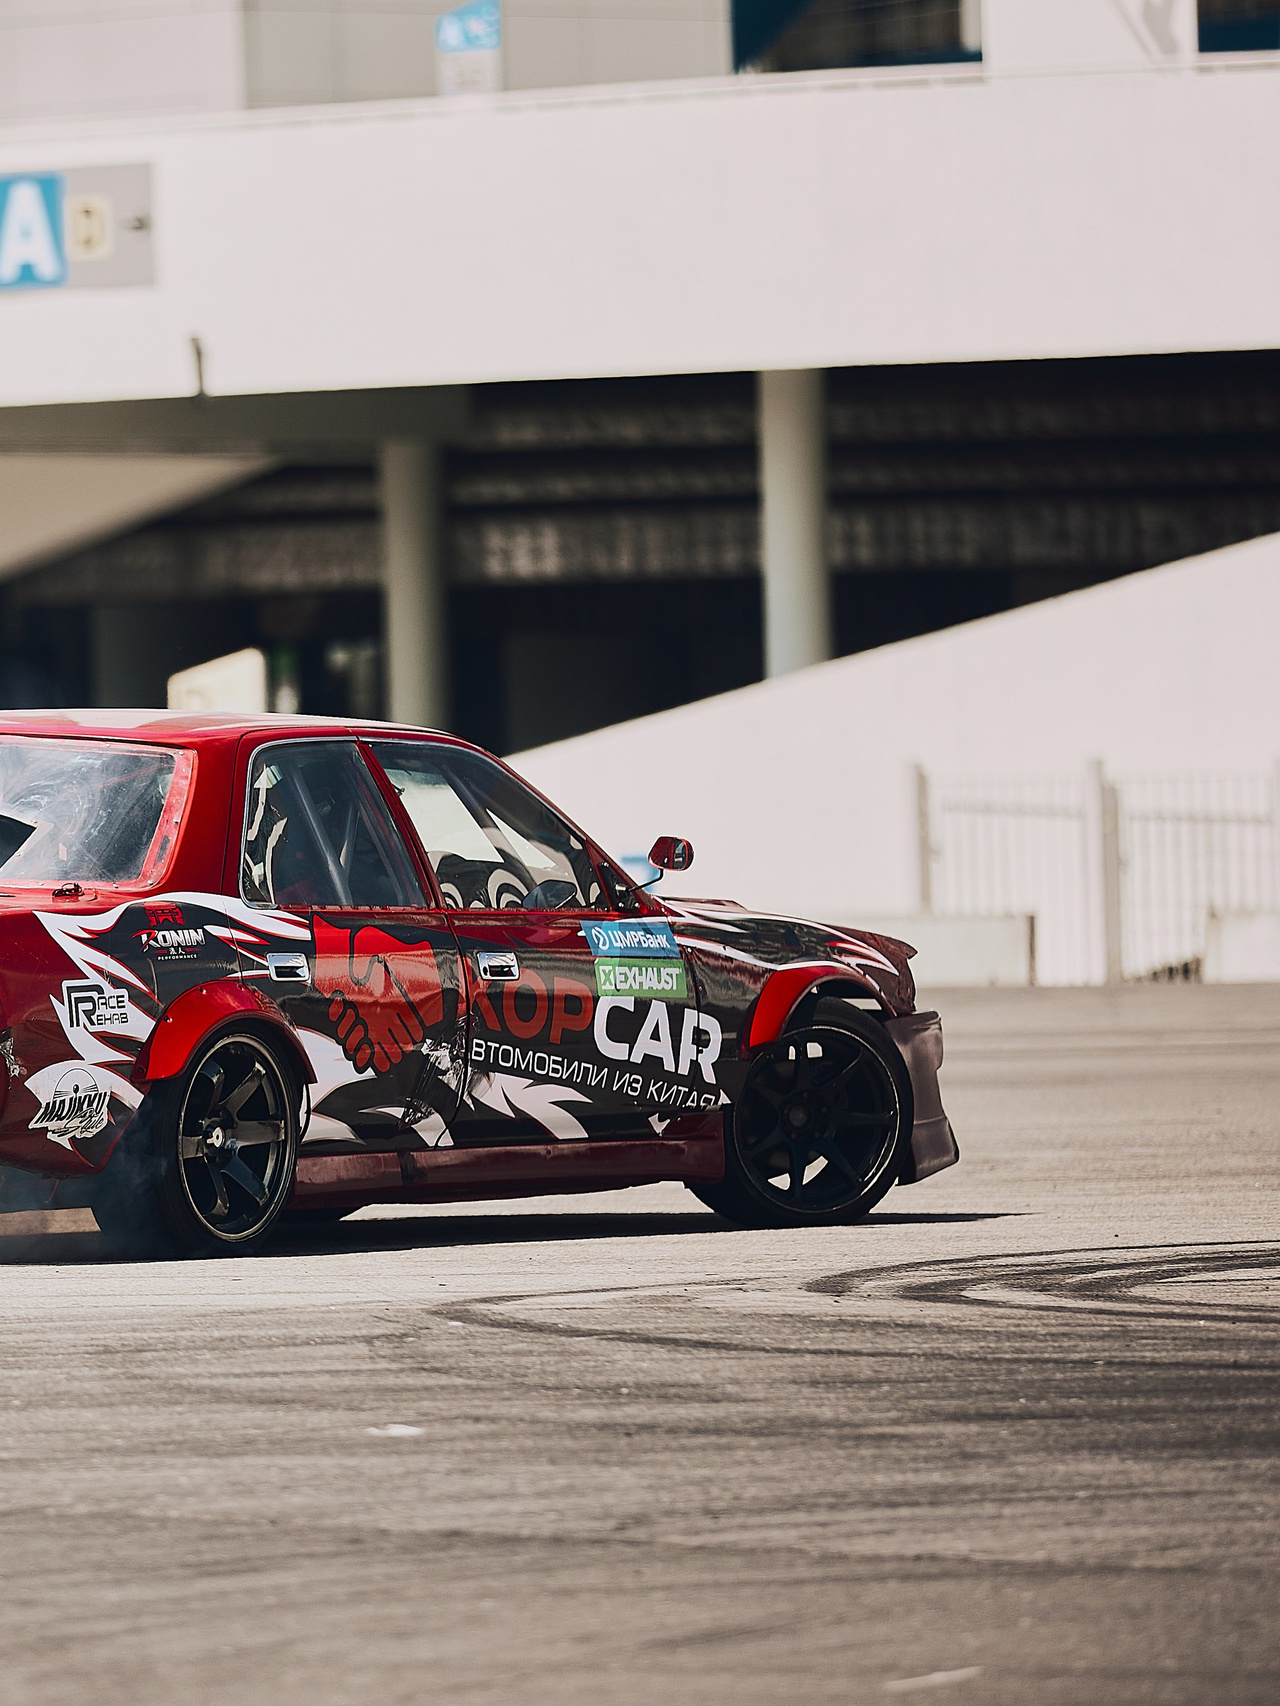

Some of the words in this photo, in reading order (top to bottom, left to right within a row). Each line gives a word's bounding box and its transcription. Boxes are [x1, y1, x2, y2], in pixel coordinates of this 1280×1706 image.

[132, 929, 206, 953] RONIN
[609, 930, 671, 949] ЦМРБанк
[616, 966, 680, 990] EXHAUST
[612, 1070, 643, 1097] ИЗ
